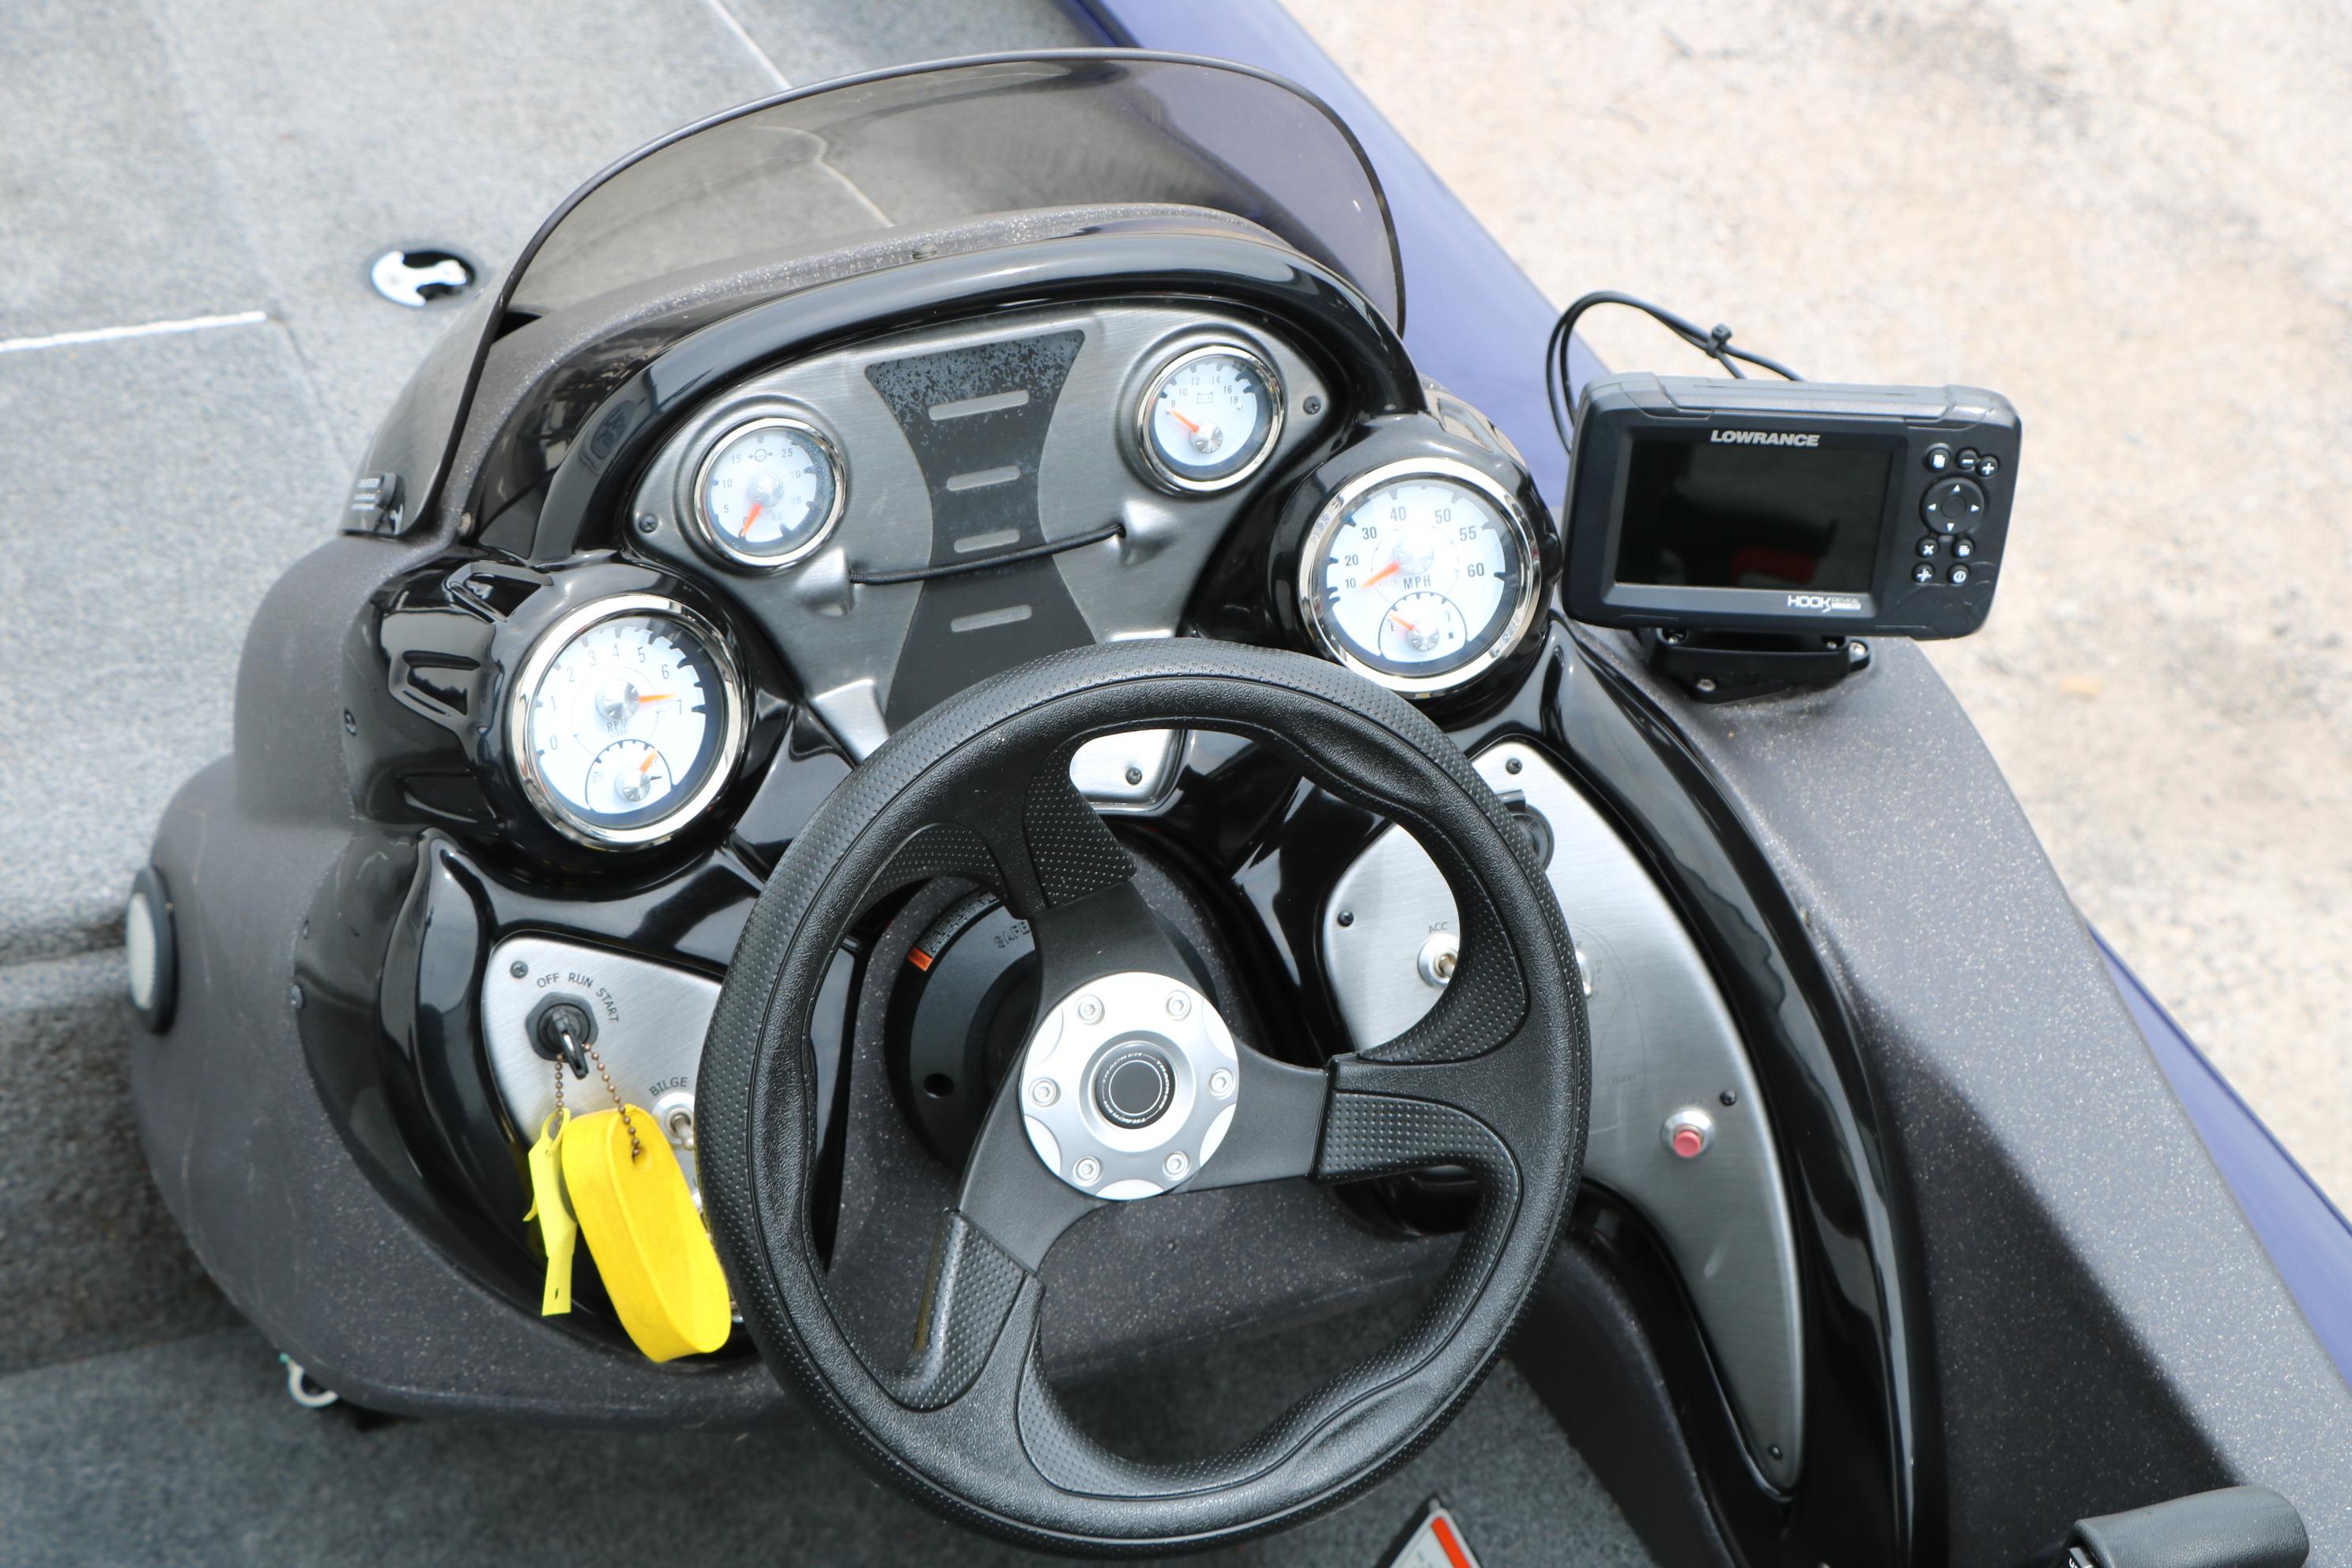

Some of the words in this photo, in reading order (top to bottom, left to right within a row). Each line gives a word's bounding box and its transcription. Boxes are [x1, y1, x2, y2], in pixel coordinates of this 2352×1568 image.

[1192, 377, 1200, 386] 12
[1212, 376, 1220, 385] 14
[1178, 388, 1187, 397] 10
[1223, 385, 1232, 394] 16
[1171, 399, 1176, 408] 8
[1710, 429, 1821, 447] LOWRANCE
[732, 454, 741, 464] 15
[782, 448, 793, 458] 25
[722, 478, 733, 488] 10
[724, 504, 729, 514] 5
[1389, 506, 1407, 522] 40
[1434, 507, 1452, 524] 50
[1361, 526, 1378, 541] 30
[1459, 525, 1477, 542] 55
[1344, 553, 1359, 567] 20
[1467, 562, 1485, 578] 60
[1345, 577, 1357, 590] 10
[1403, 574, 1431, 590] MPH
[1787, 595, 1831, 613] HOOK
[587, 650, 597, 667] 3
[612, 643, 620, 660] 4
[637, 646, 646, 663] 5
[566, 666, 575, 684] 2
[661, 663, 670, 680] 6
[550, 695, 557, 711] 1
[606, 720, 628, 733] RPM
[549, 734, 558, 750] 0
[1429, 922, 1448, 934] ACC
[537, 972, 560, 988] OFF
[567, 972, 594, 988] RUN
[596, 987, 620, 1023] START
[650, 1076, 688, 1096] BILGE
